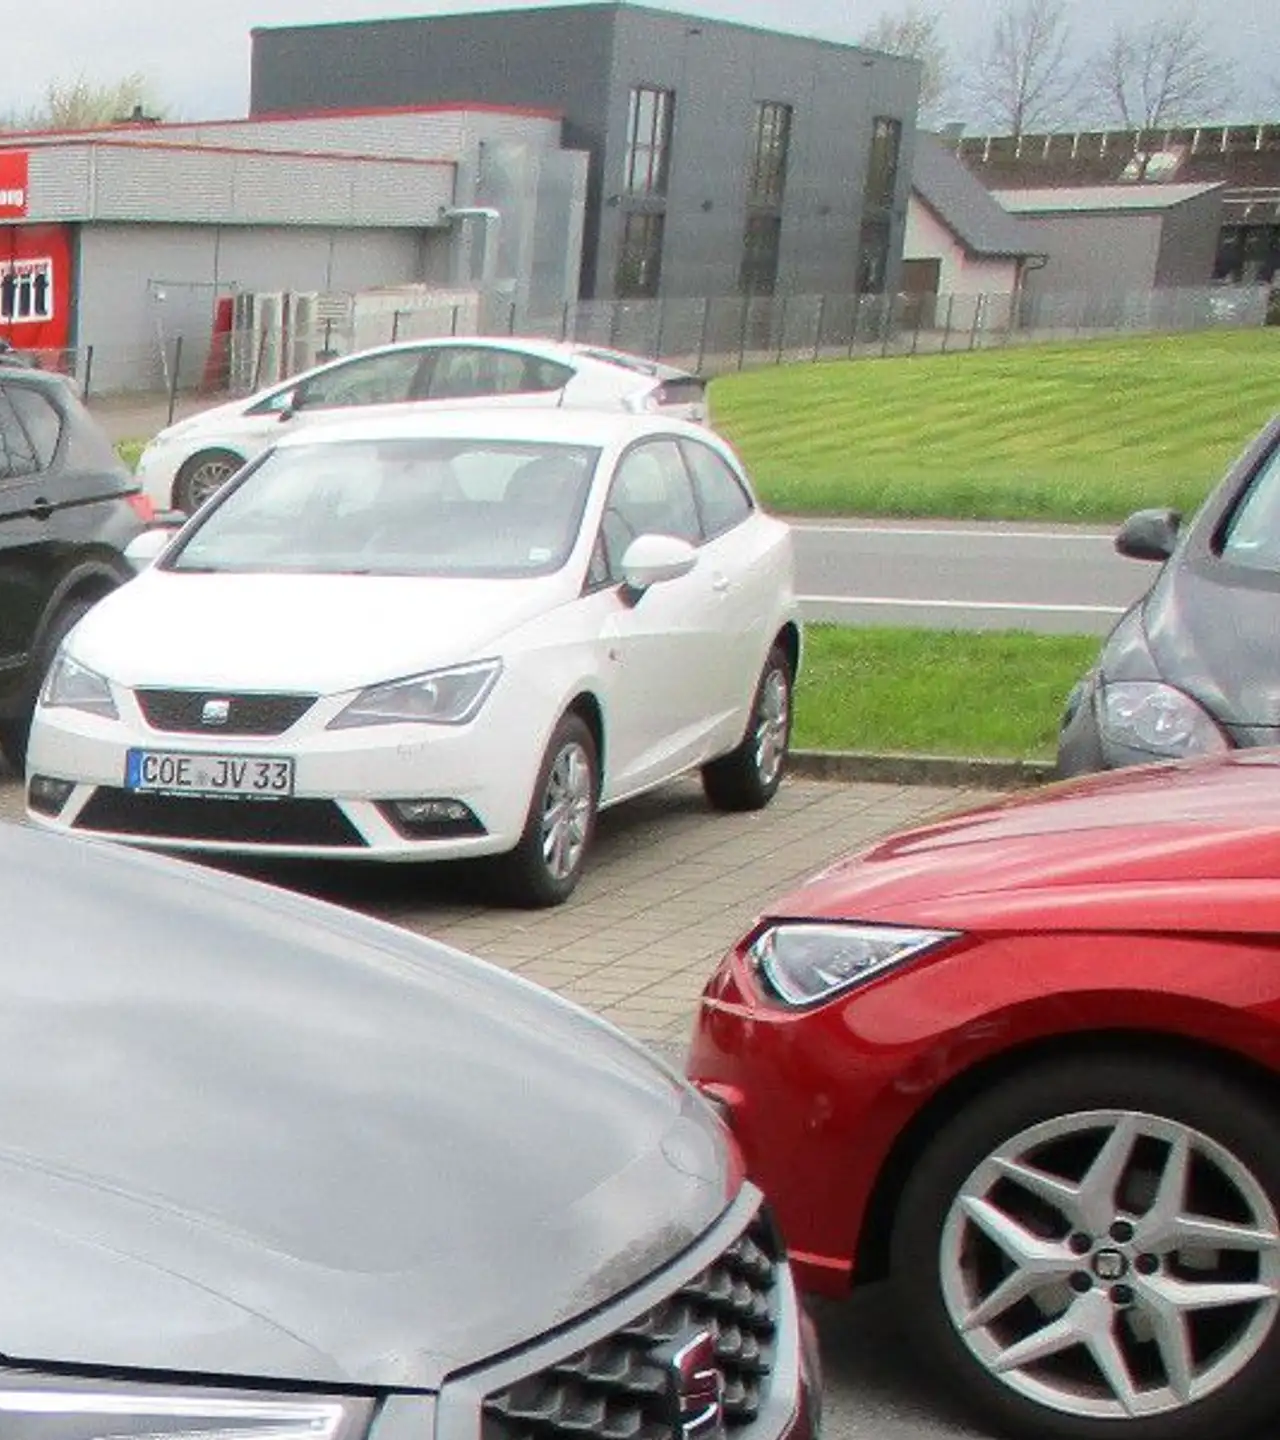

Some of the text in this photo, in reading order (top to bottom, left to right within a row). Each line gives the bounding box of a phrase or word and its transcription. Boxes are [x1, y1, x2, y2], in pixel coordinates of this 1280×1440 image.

[142, 755, 288, 791] COE JV 33
